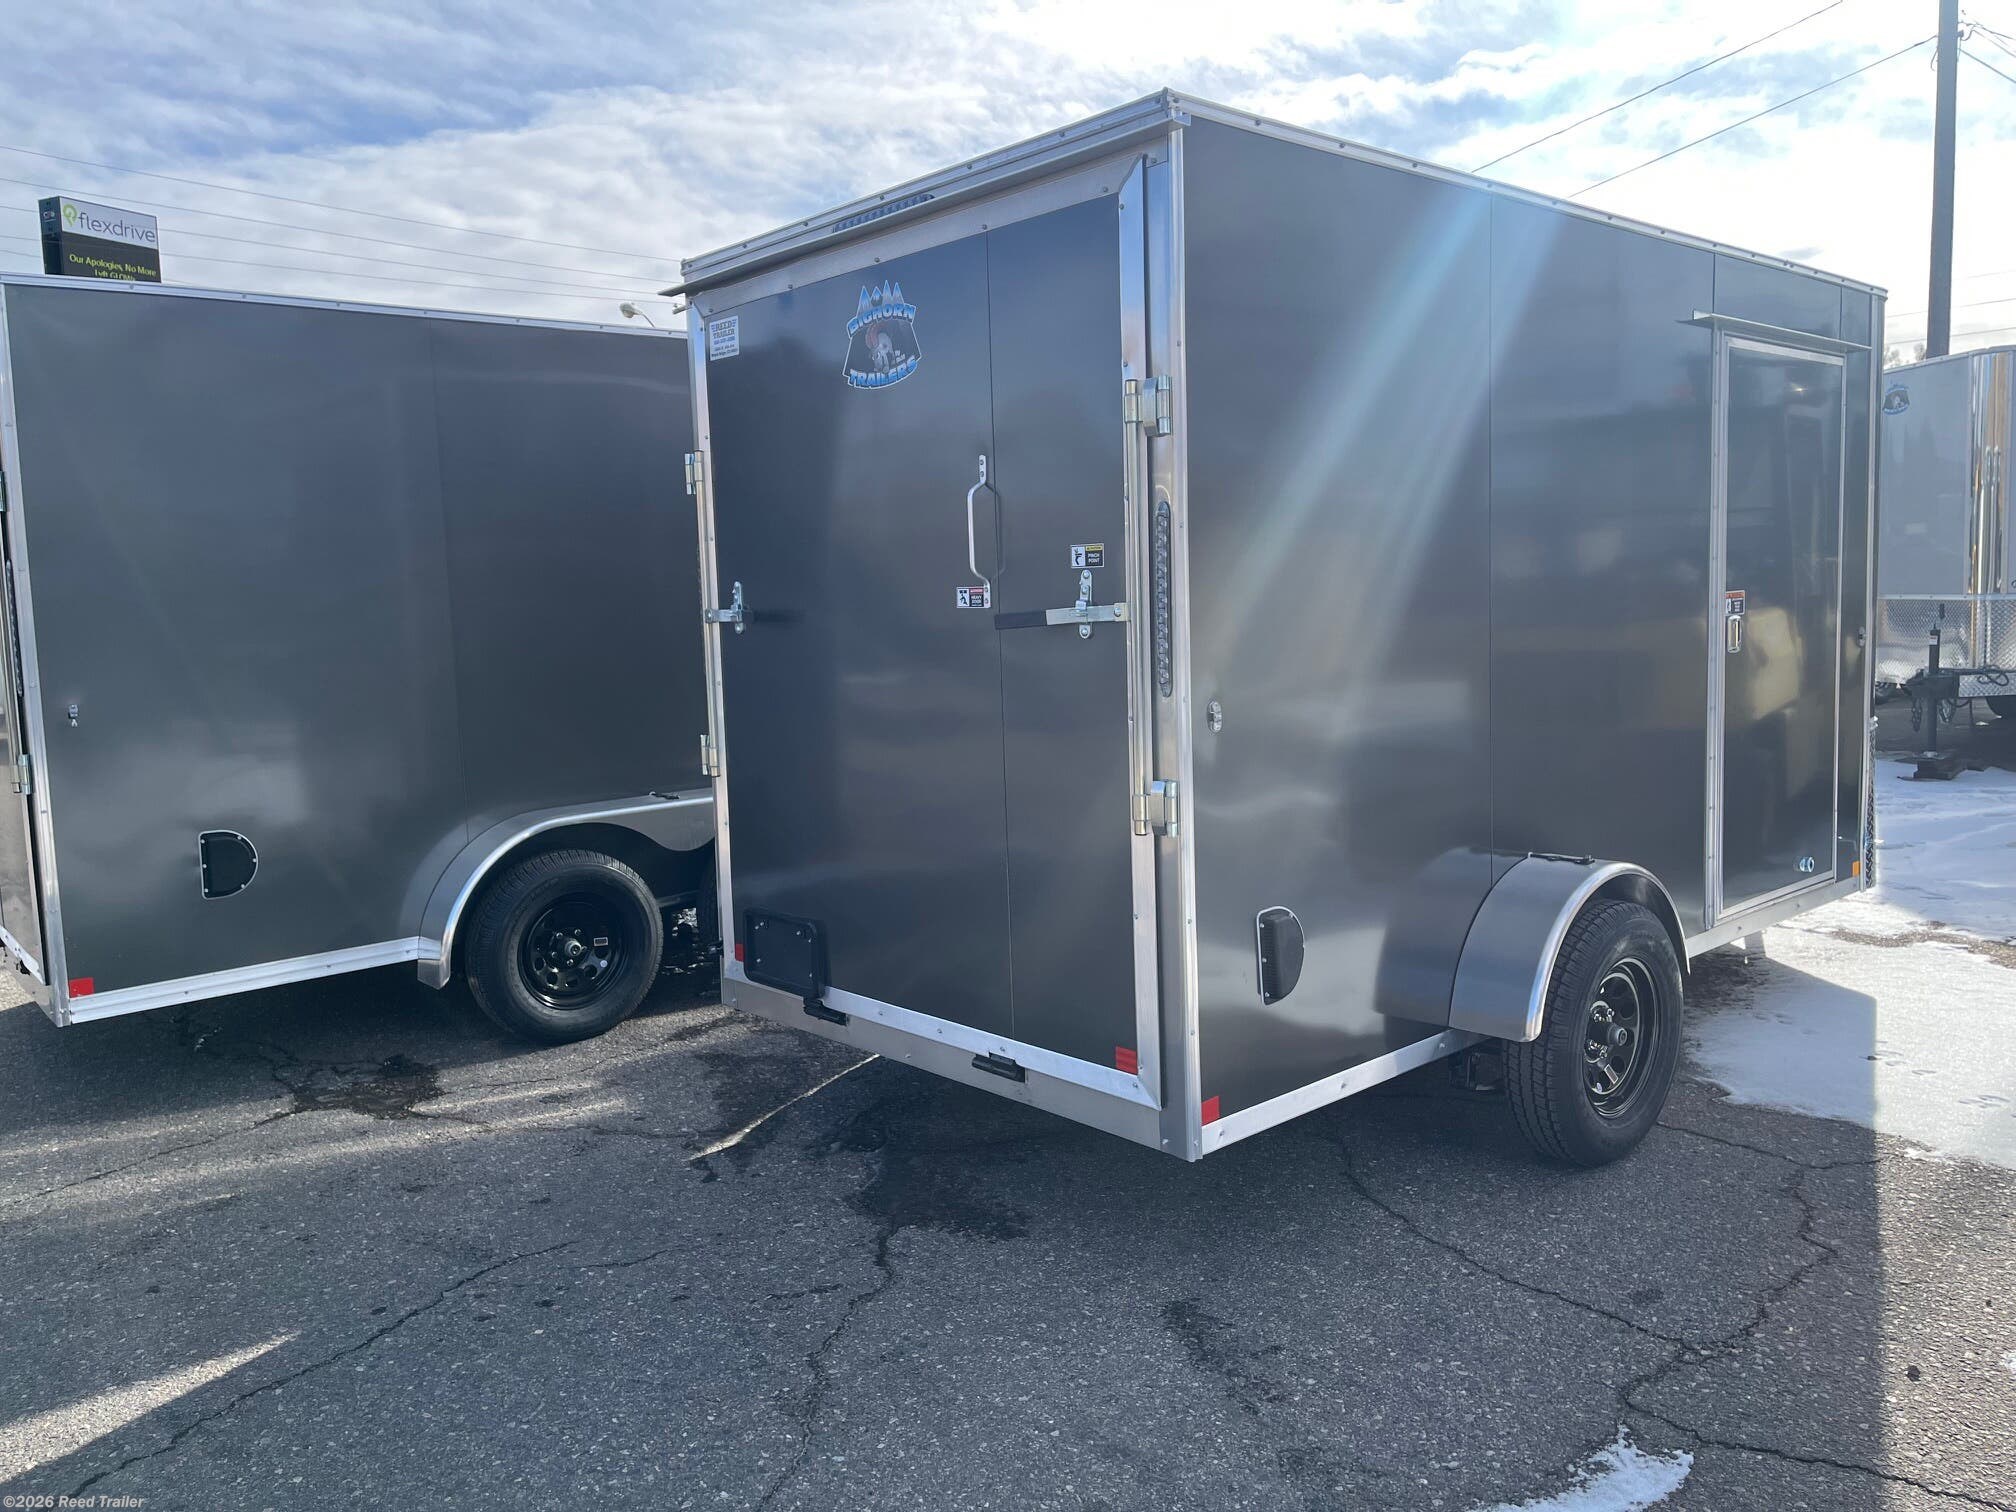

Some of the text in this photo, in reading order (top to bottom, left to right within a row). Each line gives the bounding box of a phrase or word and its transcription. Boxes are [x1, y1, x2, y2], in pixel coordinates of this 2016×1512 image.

[78, 212, 156, 243] flexdrive
[69, 253, 157, 277] Our Apologies, No More
[847, 303, 916, 336] BIGHORN
[849, 354, 918, 387] TRAILERS
